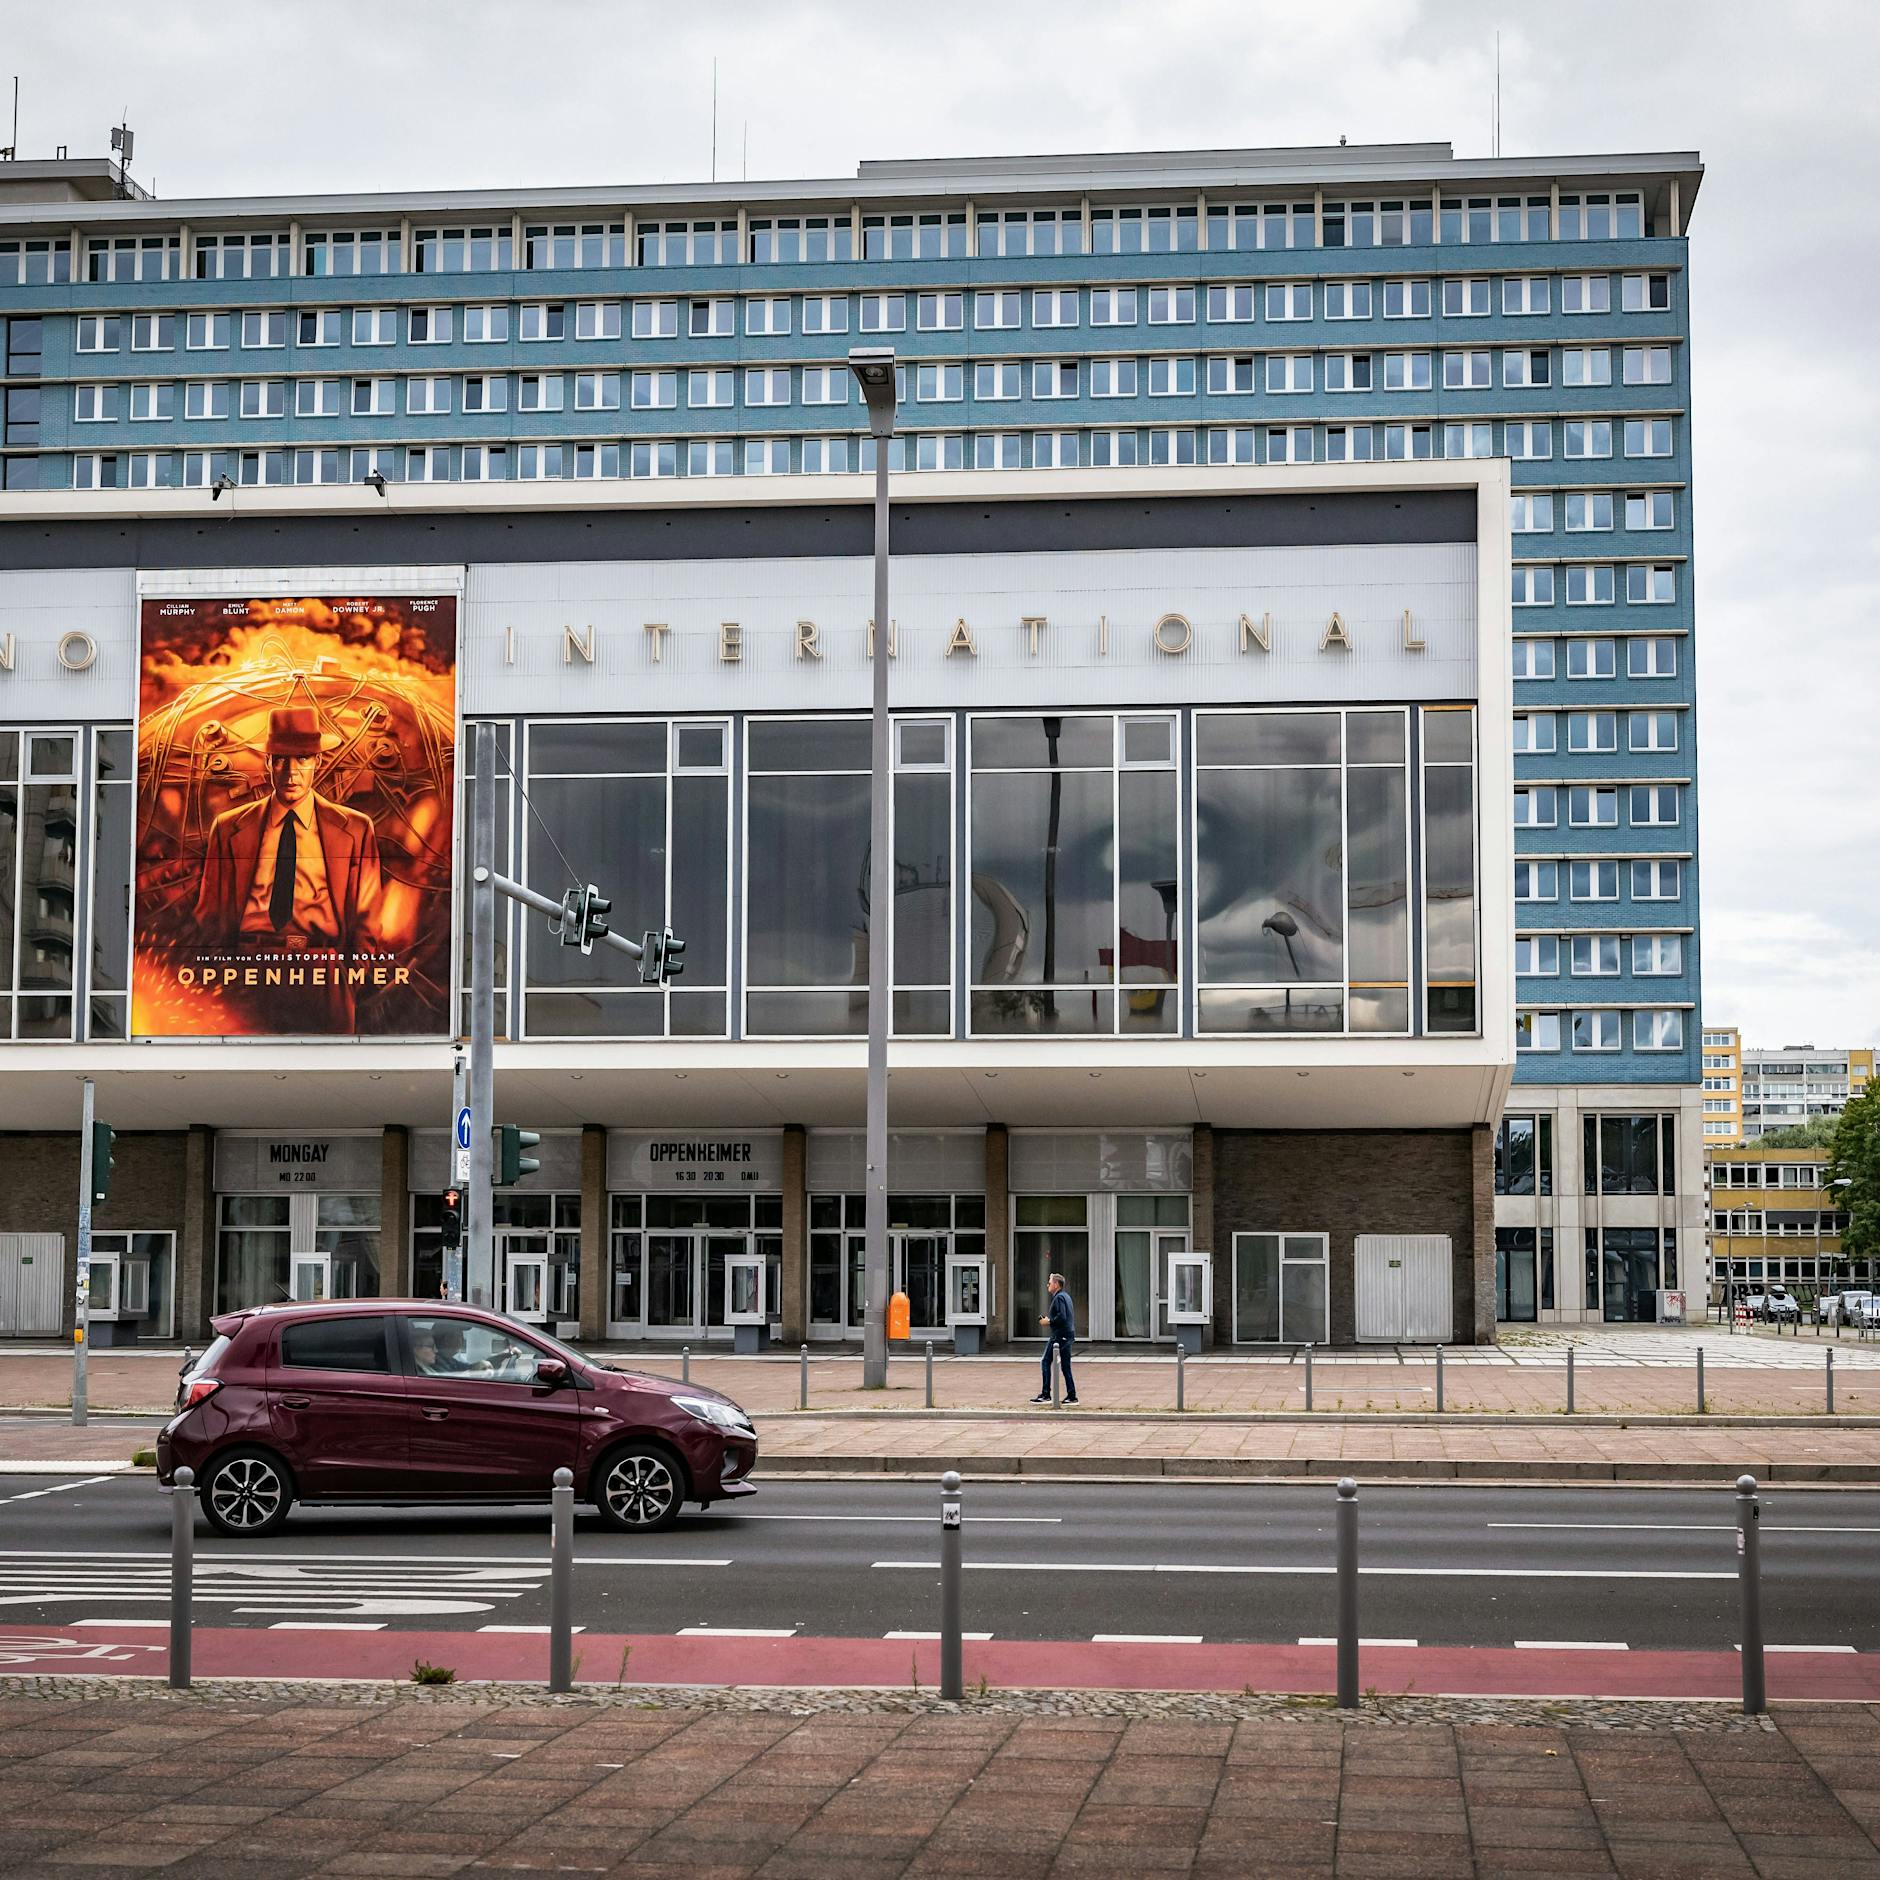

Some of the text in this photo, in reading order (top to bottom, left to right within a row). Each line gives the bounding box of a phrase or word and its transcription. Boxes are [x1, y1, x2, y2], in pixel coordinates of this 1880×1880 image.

[505, 609, 1426, 663] INTERNATIONAL
[177, 967, 411, 985] OPPENHEIMER
[269, 1144, 330, 1163] MONGAY
[650, 1143, 751, 1162] OPPENHEIMER
[279, 1172, 291, 1182] MO
